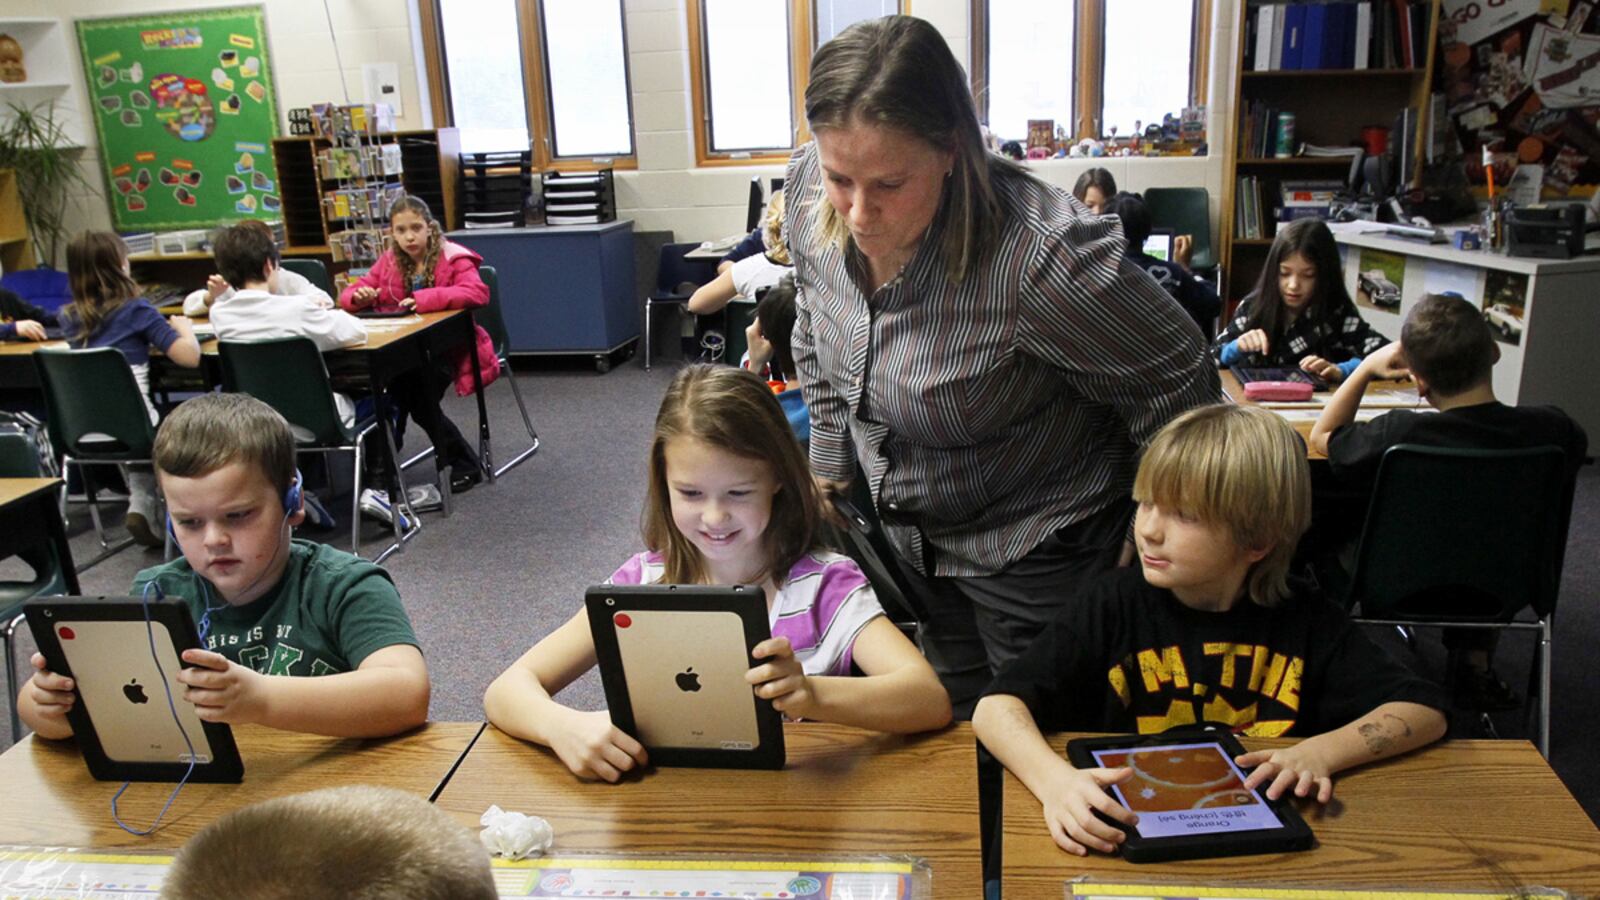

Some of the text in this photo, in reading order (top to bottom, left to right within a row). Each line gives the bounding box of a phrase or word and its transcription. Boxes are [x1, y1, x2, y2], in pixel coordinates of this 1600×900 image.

[207, 634, 239, 650] HIS
[246, 626, 264, 643] IS
[1203, 642, 1304, 712] THE
[1186, 820, 1231, 828] Orange
